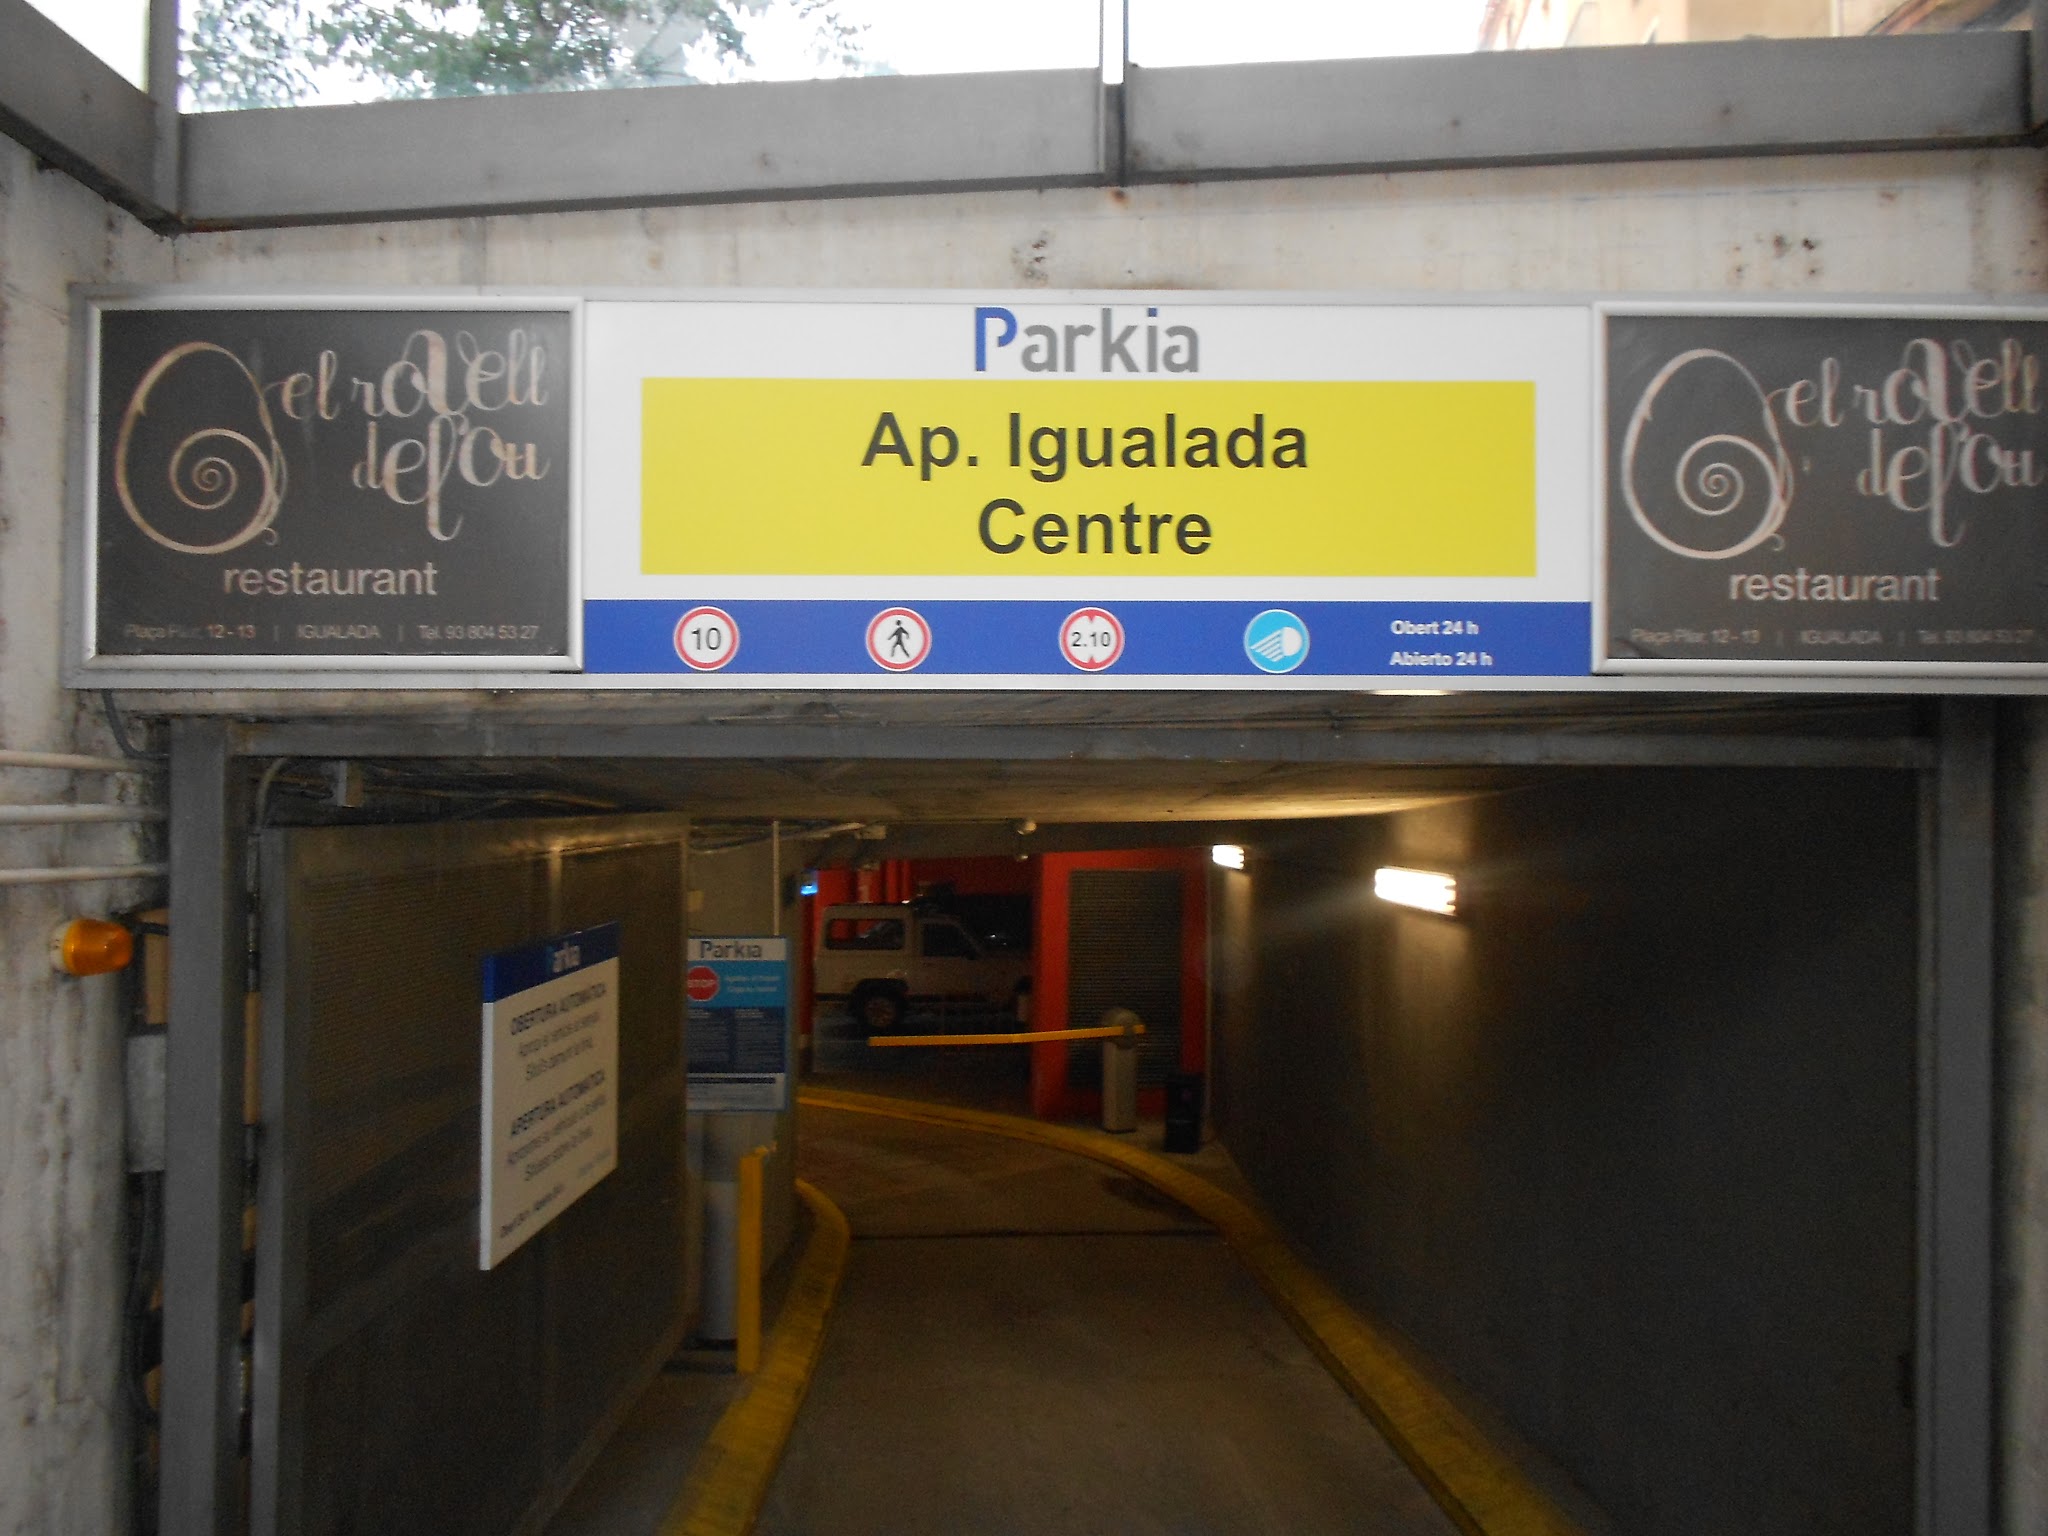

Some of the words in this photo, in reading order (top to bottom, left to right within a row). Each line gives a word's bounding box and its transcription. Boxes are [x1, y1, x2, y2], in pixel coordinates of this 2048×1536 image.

[975, 306, 1199, 373] Parkia
[861, 411, 979, 482] Ap.
[1009, 412, 1308, 483] Igualada
[978, 497, 1213, 556] Centre
[223, 562, 438, 596] restaurant
[1728, 568, 1941, 601] restaurant
[297, 624, 381, 639] IGUALADA
[520, 625, 540, 639] 27
[1390, 619, 1440, 635] Obert
[1442, 620, 1464, 634] 24
[1466, 620, 1480, 635] h
[691, 627, 722, 651] 10
[1071, 631, 1111, 647] 2.10
[1389, 651, 1453, 667] Abierto
[1456, 652, 1478, 666] 24
[1480, 652, 1493, 666] h
[700, 940, 762, 959] Parkia
